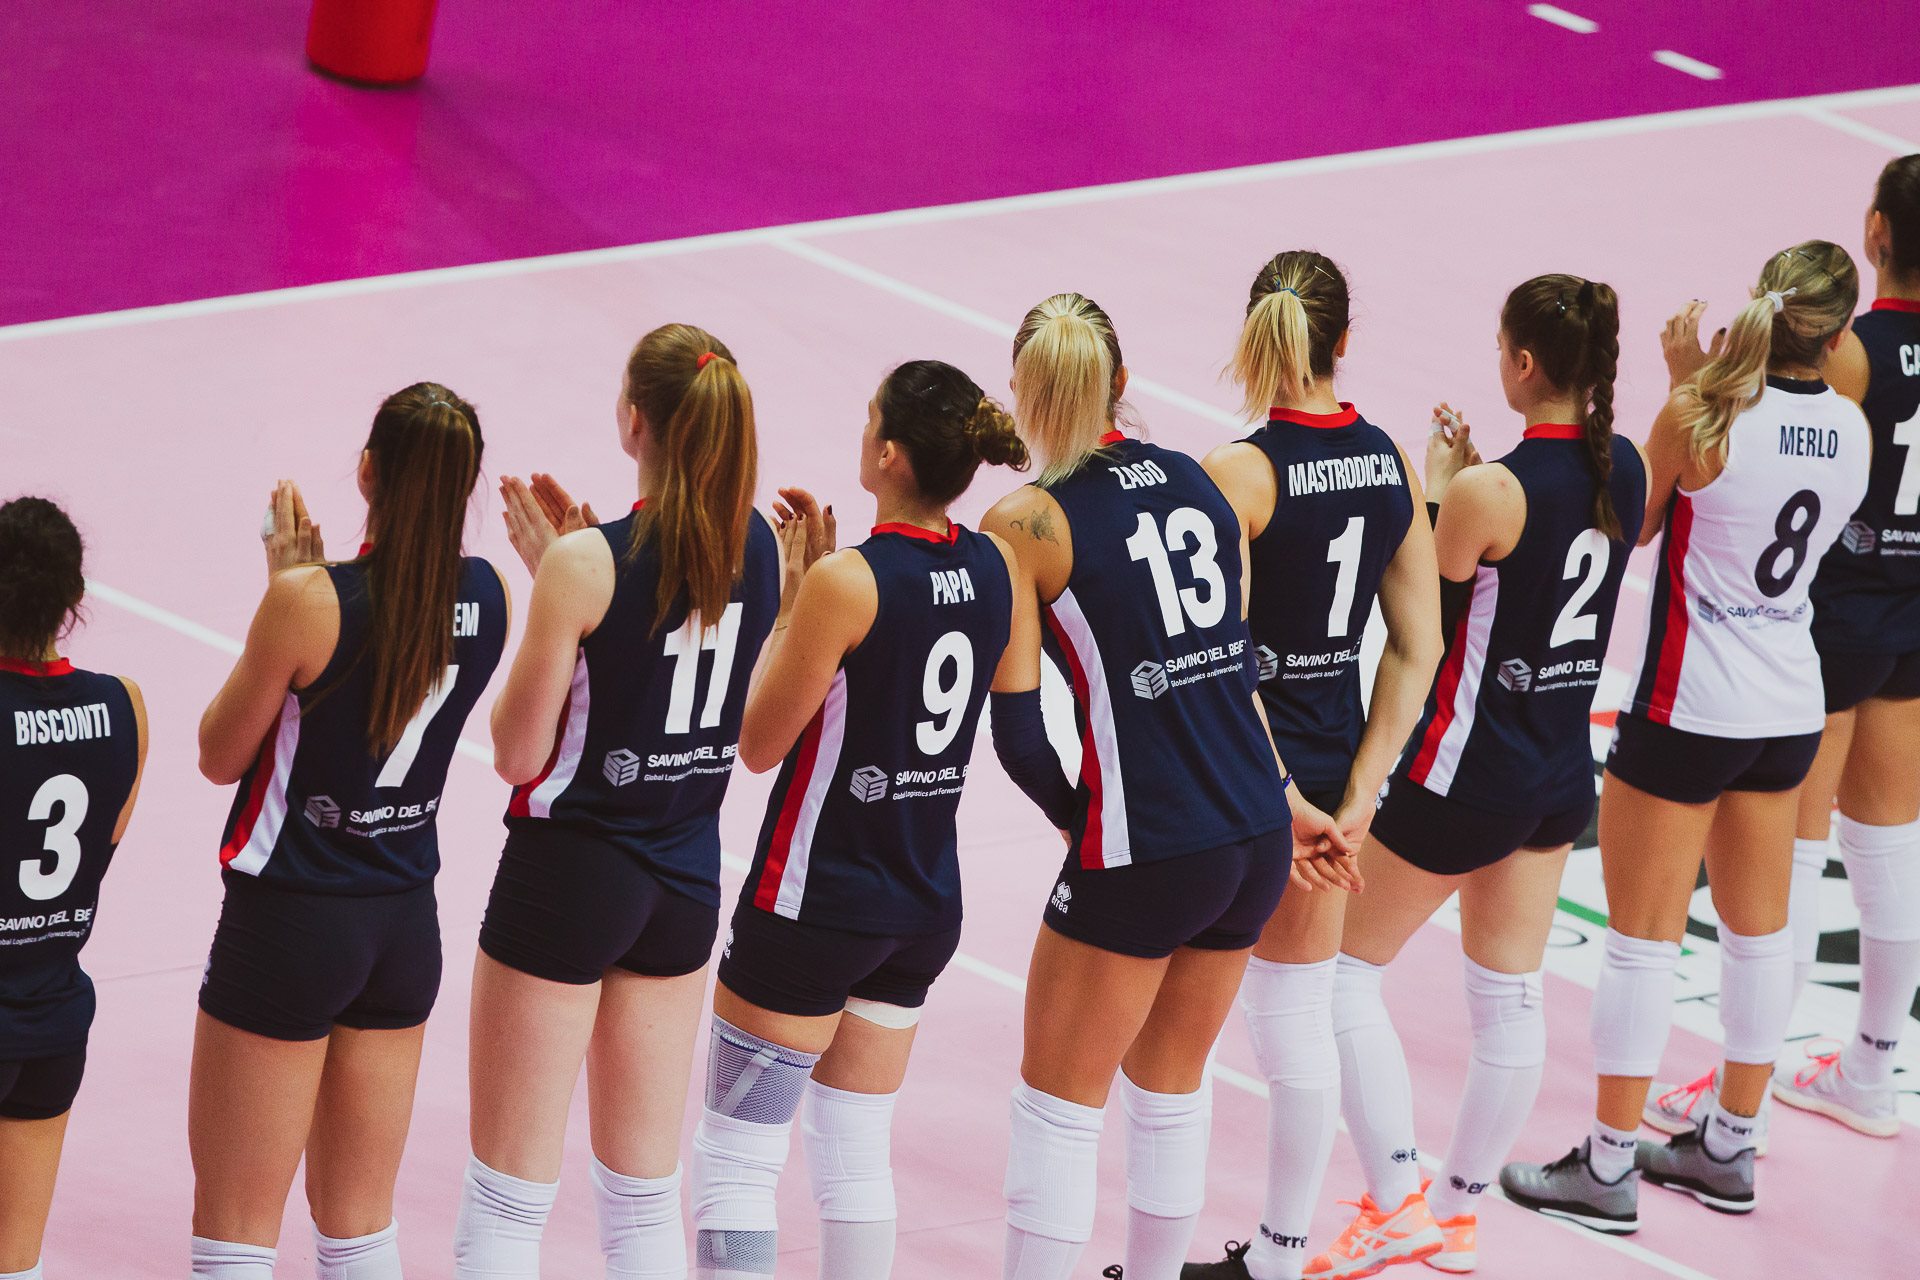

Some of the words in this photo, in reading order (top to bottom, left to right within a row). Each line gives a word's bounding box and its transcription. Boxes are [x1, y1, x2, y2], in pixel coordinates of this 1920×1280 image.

[1779, 425, 1838, 459] MERLO
[1108, 459, 1168, 490] ZAGO
[1288, 453, 1402, 497] MASTRODICASA
[1754, 489, 1821, 598] 8
[930, 567, 976, 606] PAPA
[1125, 507, 1227, 638] 13
[1326, 516, 1365, 637] 1
[1549, 527, 1611, 648] 2
[663, 601, 744, 734] 11
[1165, 650, 1208, 673] SAVINO
[1207, 646, 1228, 662] DEL
[1286, 653, 1331, 667] SAVINO
[1538, 661, 1574, 680] SAVINO
[1575, 659, 1600, 673] DEL
[915, 631, 975, 756] 9
[14, 702, 111, 746] BISCONTI
[374, 664, 460, 787] 7
[647, 750, 692, 768] SAVINO
[692, 746, 718, 761] DEL
[895, 770, 937, 786] SAVINO
[937, 766, 960, 782] DEL
[349, 806, 395, 824] SAVINO
[397, 804, 422, 818] DEL
[18, 773, 90, 901] 3
[0, 915, 46, 931] SAVINO
[47, 910, 70, 926] DEL
